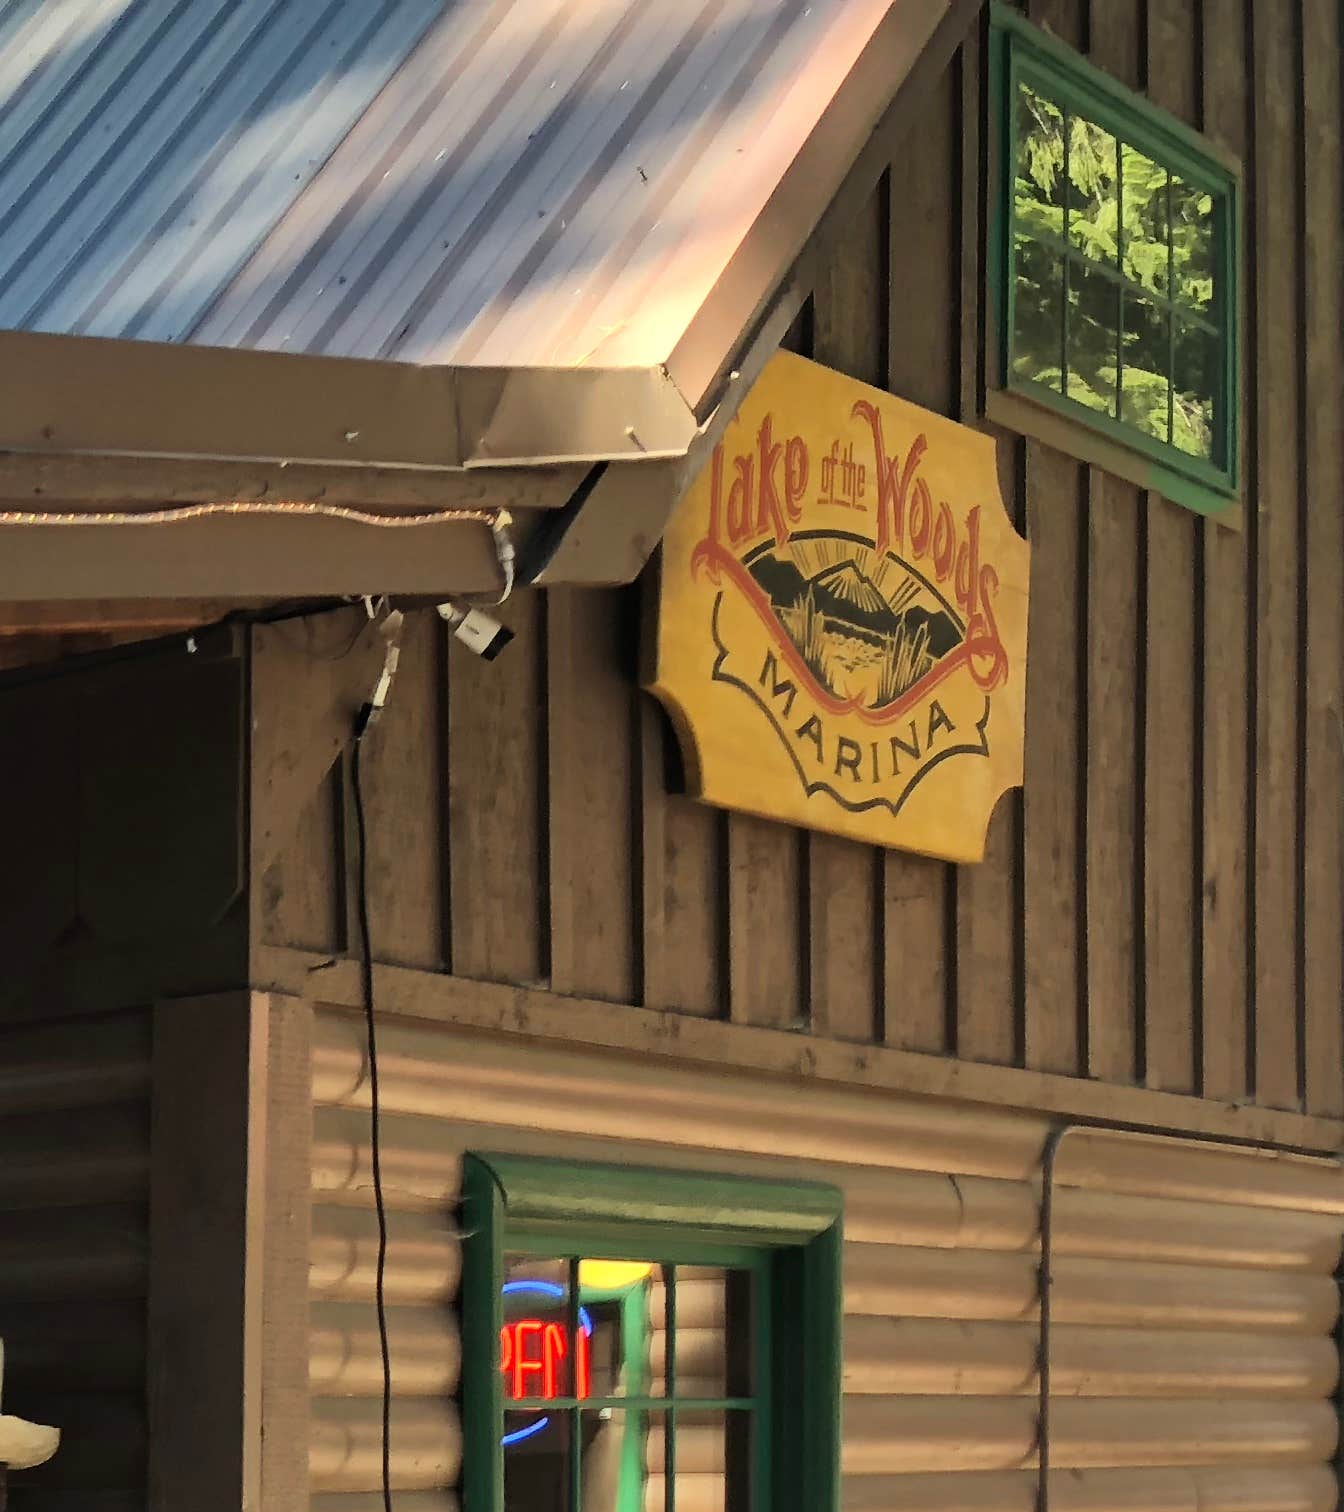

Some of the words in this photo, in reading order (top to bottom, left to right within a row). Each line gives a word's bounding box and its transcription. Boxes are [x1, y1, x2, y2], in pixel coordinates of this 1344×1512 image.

[705, 411, 810, 548] Lake
[820, 440, 840, 494] of
[840, 442, 867, 499] the
[850, 399, 1001, 620] Woods
[759, 646, 957, 784] MARINA
